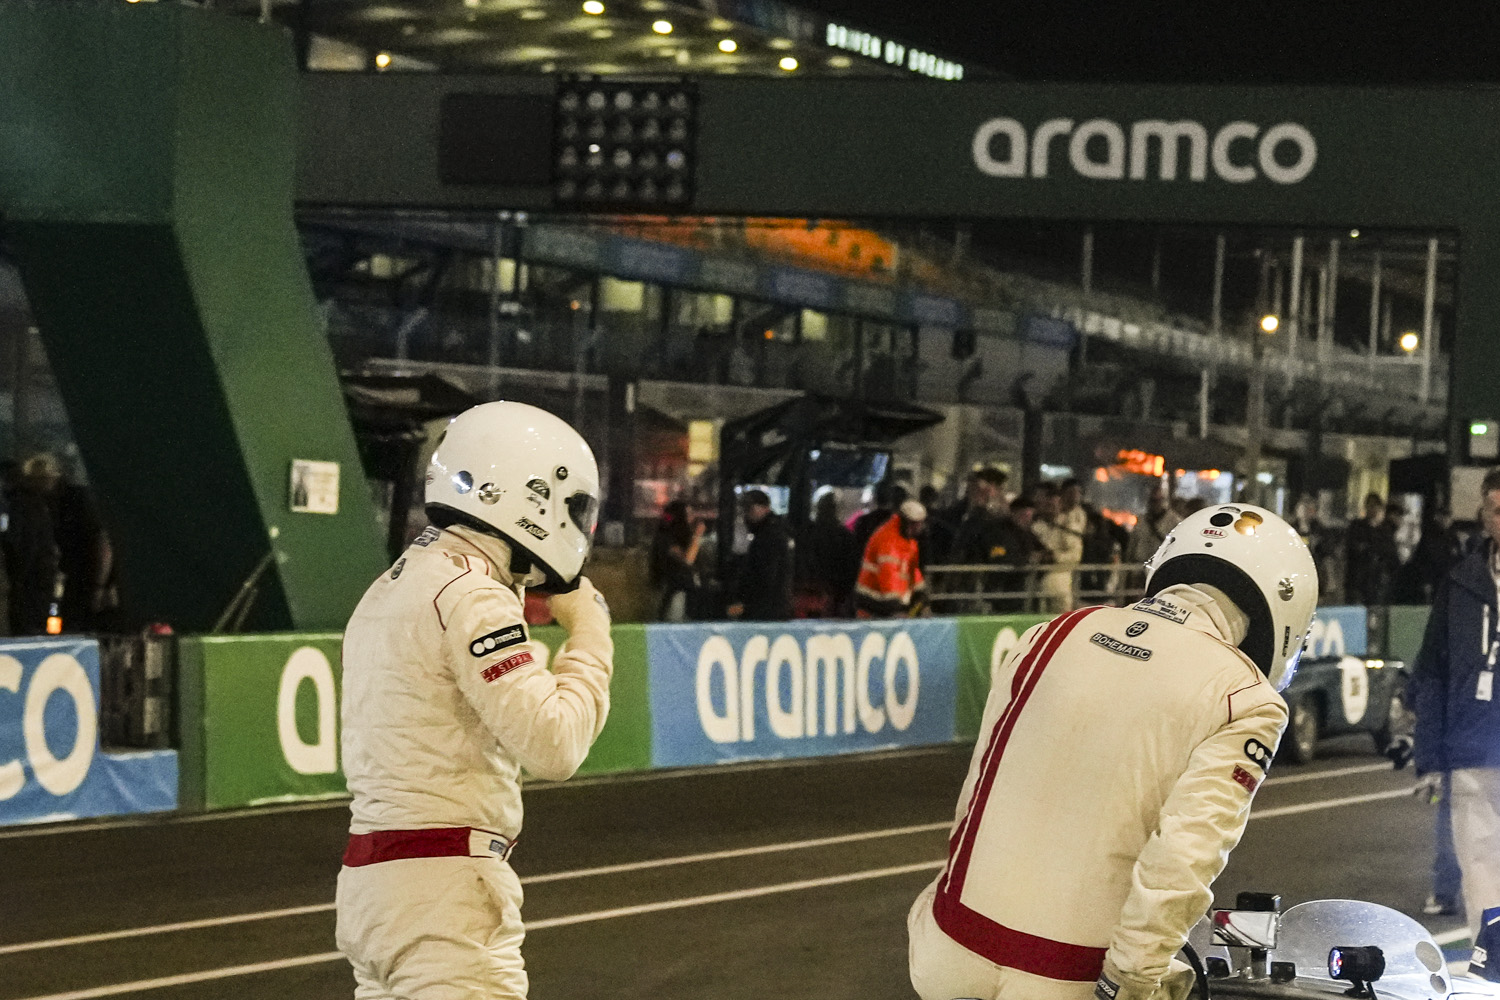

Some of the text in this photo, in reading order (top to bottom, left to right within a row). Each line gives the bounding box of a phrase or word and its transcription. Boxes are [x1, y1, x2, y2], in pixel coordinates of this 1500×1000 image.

[885, 40, 905, 66] BY
[972, 117, 1318, 184] aramco
[1203, 529, 1224, 538] BELL
[1093, 632, 1151, 660] BOHEMATIC
[695, 631, 920, 744] aramco
